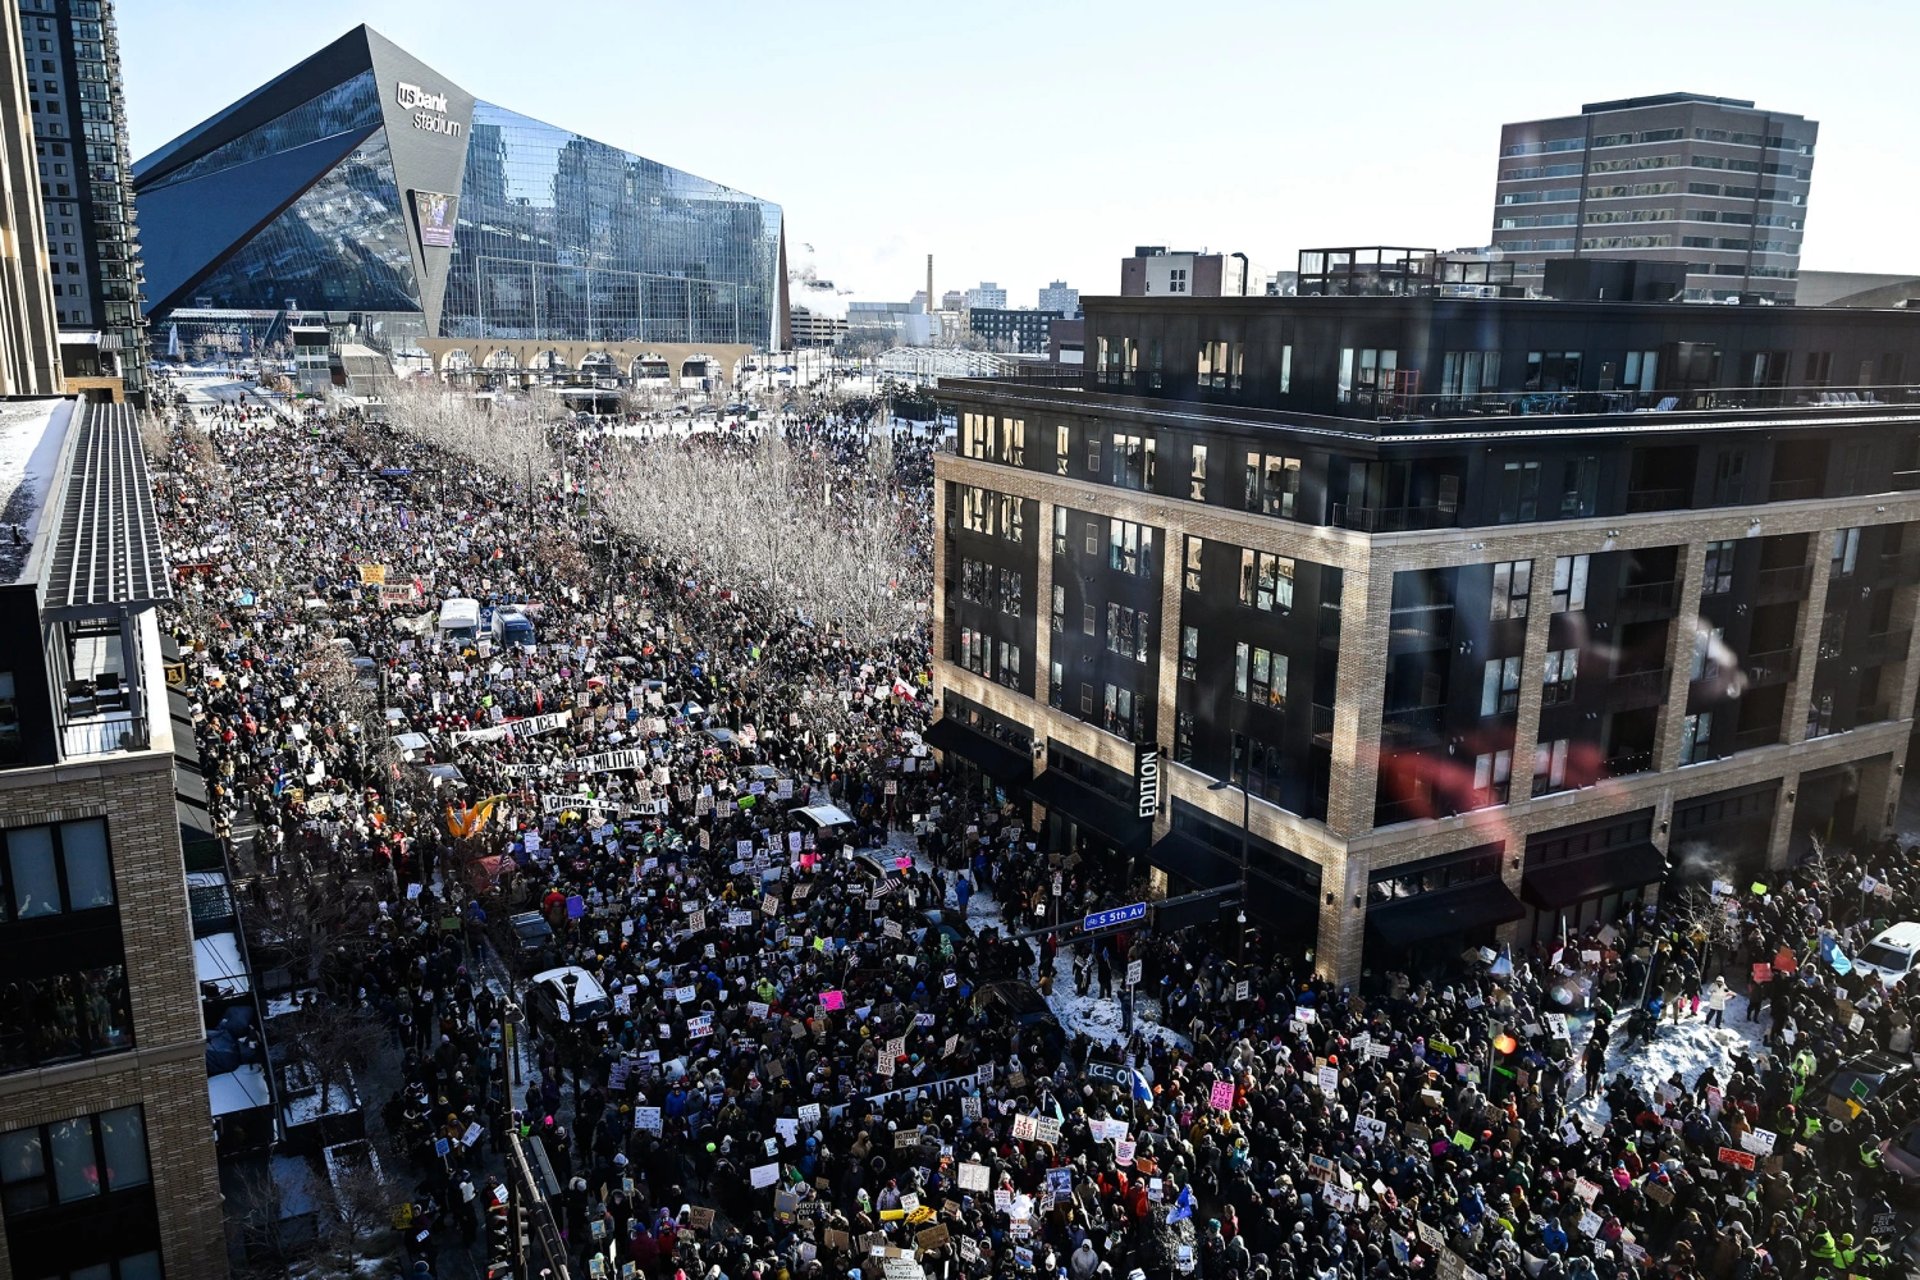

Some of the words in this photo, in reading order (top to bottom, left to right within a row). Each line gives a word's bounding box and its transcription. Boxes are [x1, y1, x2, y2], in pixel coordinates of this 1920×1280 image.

[413, 111, 462, 137] stadium
[511, 720, 534, 737] FOR
[536, 714, 558, 732] ICE!
[593, 750, 640, 771] MILITIA!
[1139, 751, 1158, 818] EDITION
[1100, 914, 1106, 924] S
[1109, 911, 1127, 923] 5th
[1130, 906, 1144, 918] Av
[688, 1018, 699, 1028] WE
[879, 1056, 893, 1065] ICE
[1088, 1063, 1114, 1080] ICE
[1213, 1089, 1232, 1098] OUT
[1214, 1081, 1232, 1090] ICE
[1210, 1101, 1230, 1111] GOOD
[1212, 1096, 1230, 1104] FOR
[799, 1107, 818, 1116] ICE
[1017, 1120, 1033, 1130] ICE
[1755, 1130, 1775, 1146] ICE
[1308, 1165, 1332, 1182] OUT
[1442, 1249, 1457, 1266] NO
